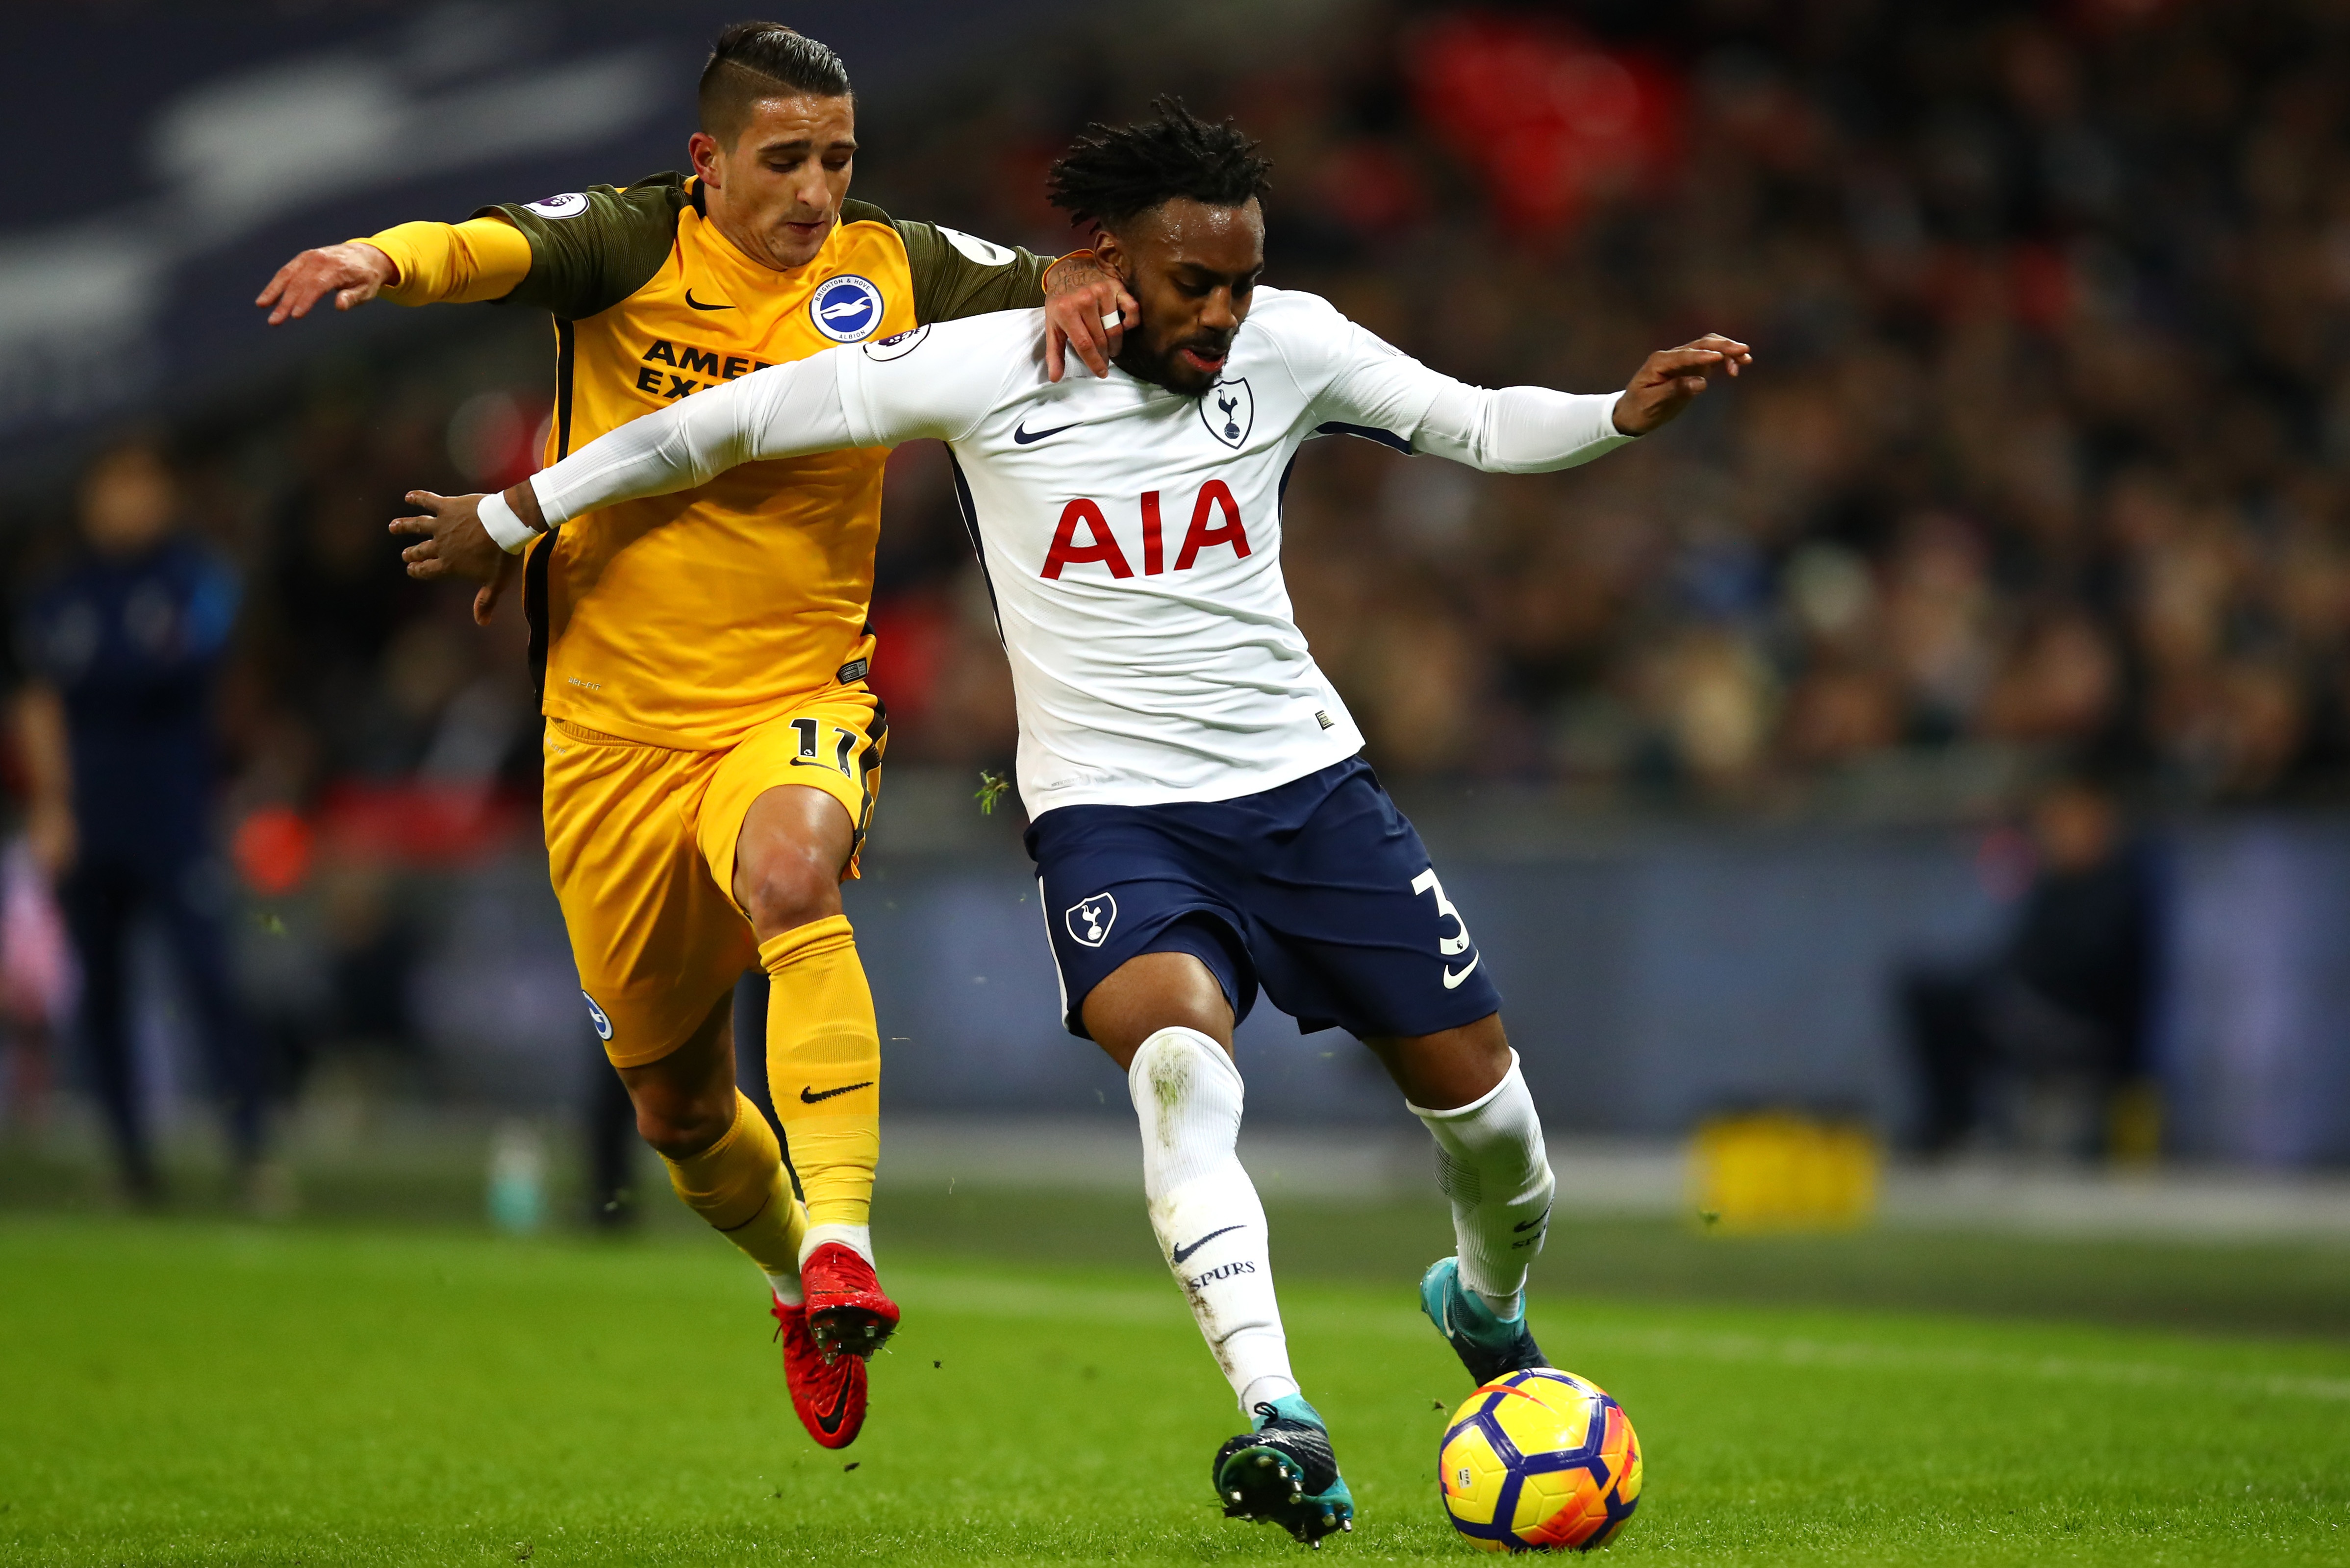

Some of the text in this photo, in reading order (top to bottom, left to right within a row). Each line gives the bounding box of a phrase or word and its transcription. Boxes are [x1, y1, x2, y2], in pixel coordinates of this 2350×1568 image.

[815, 278, 843, 301] BRIGHTON
[854, 279, 871, 291] HOVE
[839, 330, 865, 339] ALBION
[642, 340, 774, 380] AME
[636, 367, 715, 398] EX
[1040, 479, 1252, 580] AIA
[568, 676, 601, 691] DRI-FIT
[788, 718, 858, 779] 11
[1411, 867, 1469, 955] 3
[1189, 1261, 1255, 1291] SPURS
